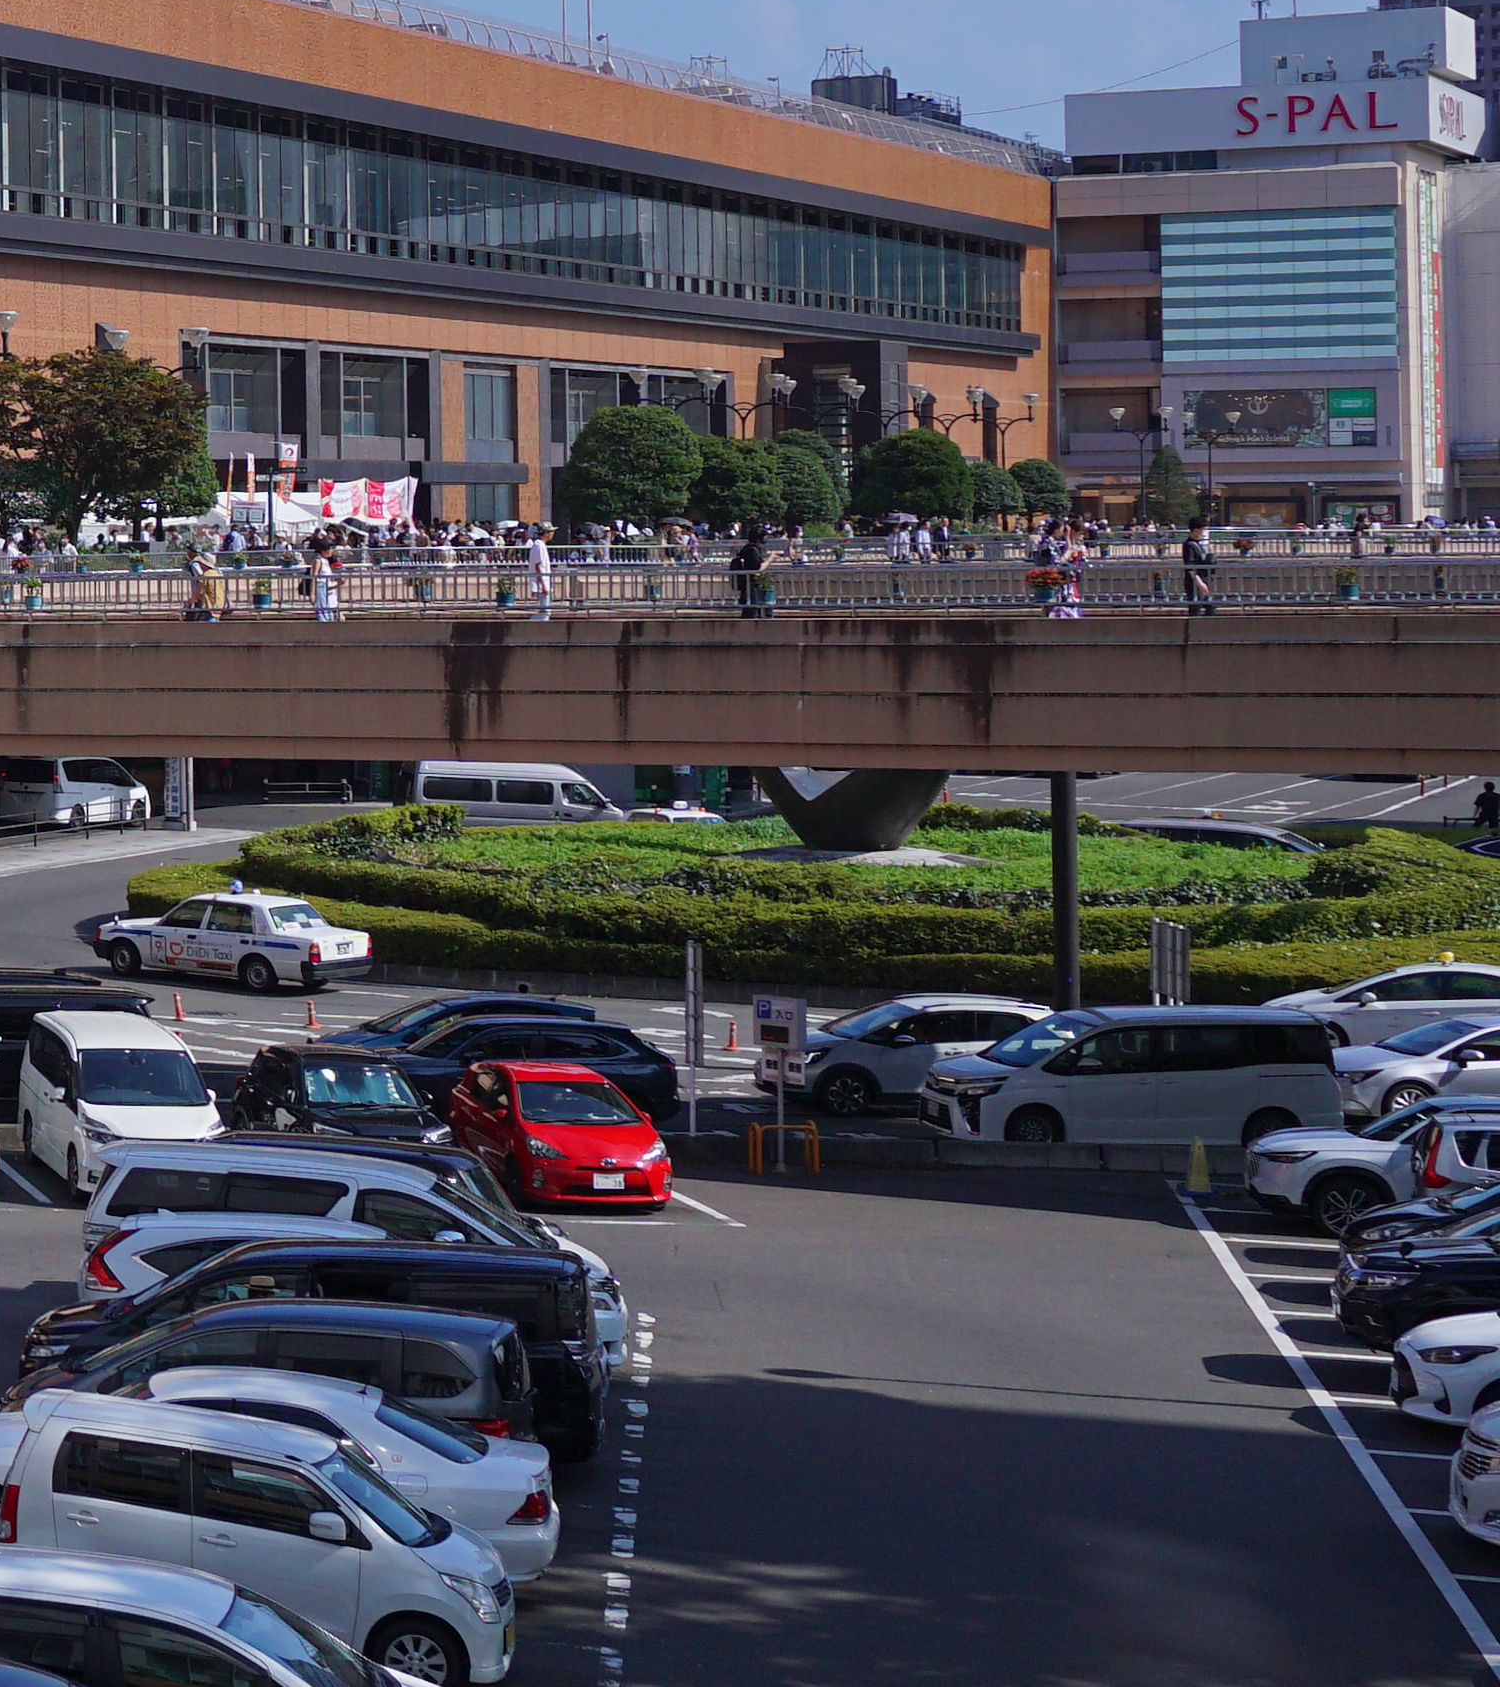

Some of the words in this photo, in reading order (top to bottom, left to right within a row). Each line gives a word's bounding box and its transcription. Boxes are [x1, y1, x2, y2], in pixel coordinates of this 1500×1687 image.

[1236, 91, 1398, 137] S-PAL
[186, 946, 209, 959] DiDi
[212, 948, 232, 961] Taxi
[775, 1010, 793, 1020] 入口
